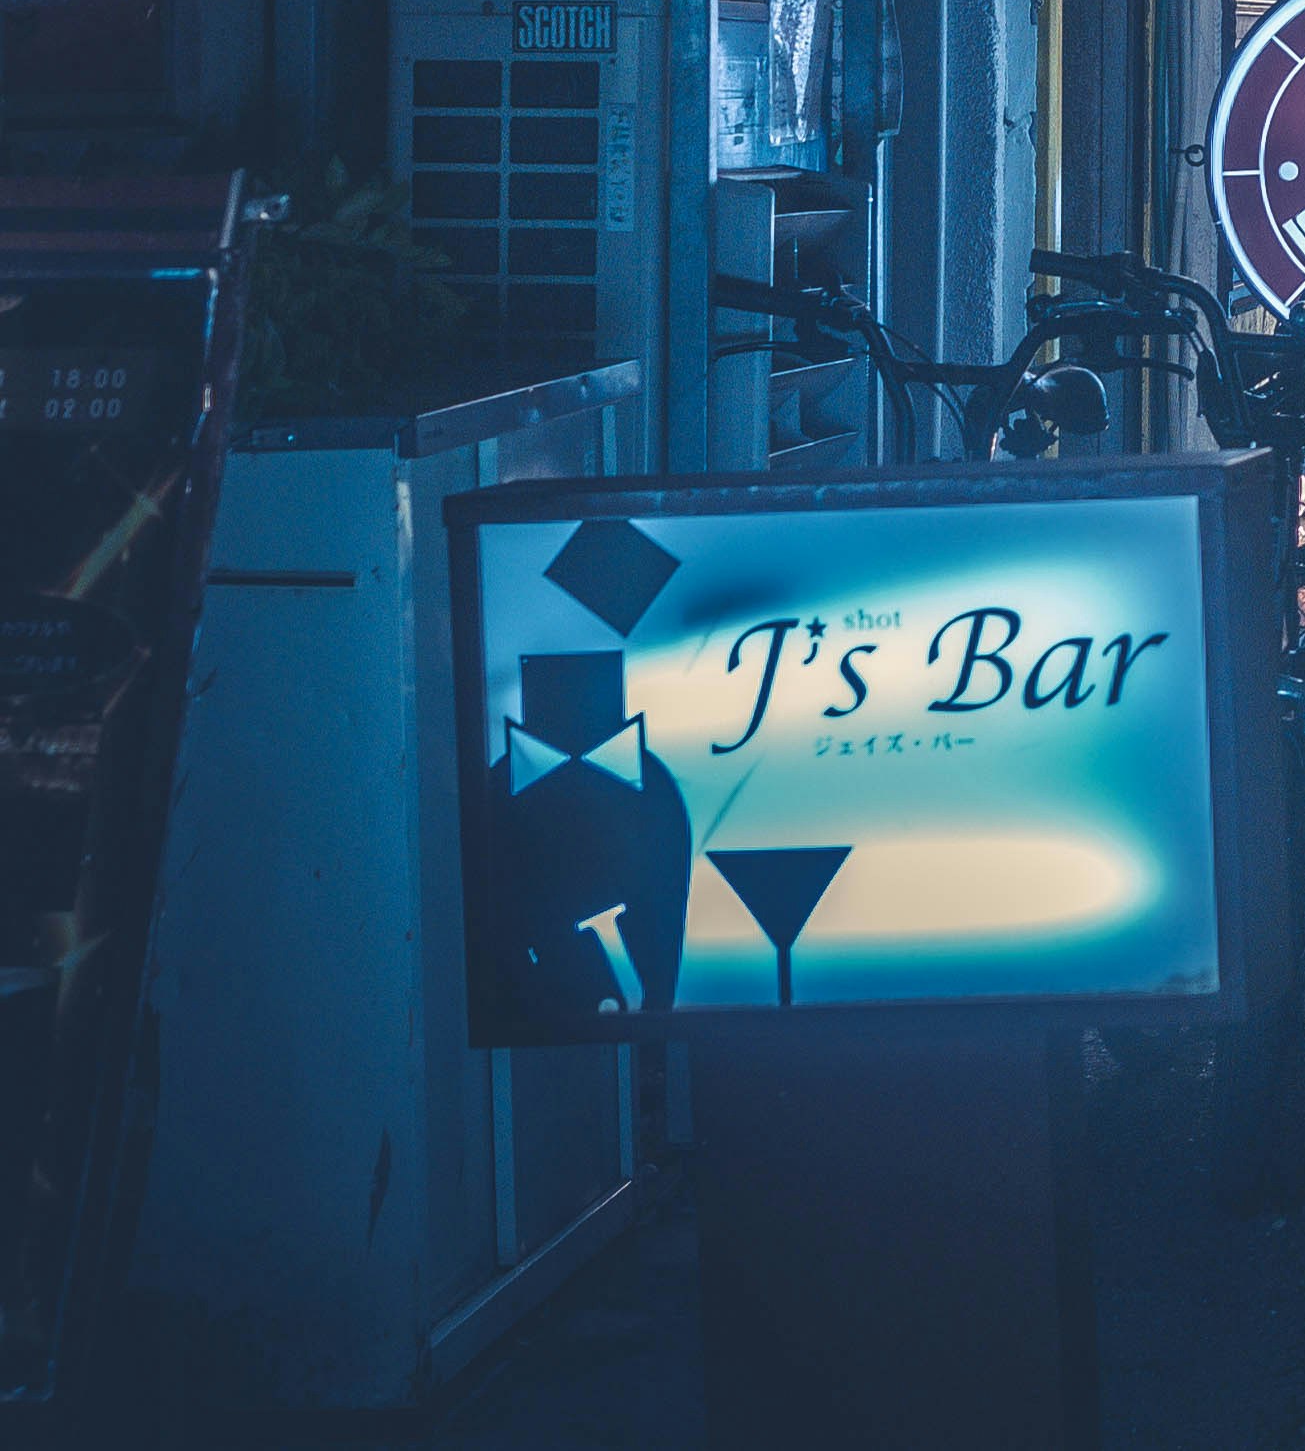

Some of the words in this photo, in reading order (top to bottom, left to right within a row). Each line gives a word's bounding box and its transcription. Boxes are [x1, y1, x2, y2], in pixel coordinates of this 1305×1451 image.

[518, 5, 612, 49] SCOTCH
[843, 607, 903, 631] shot
[927, 606, 1169, 714] Bar
